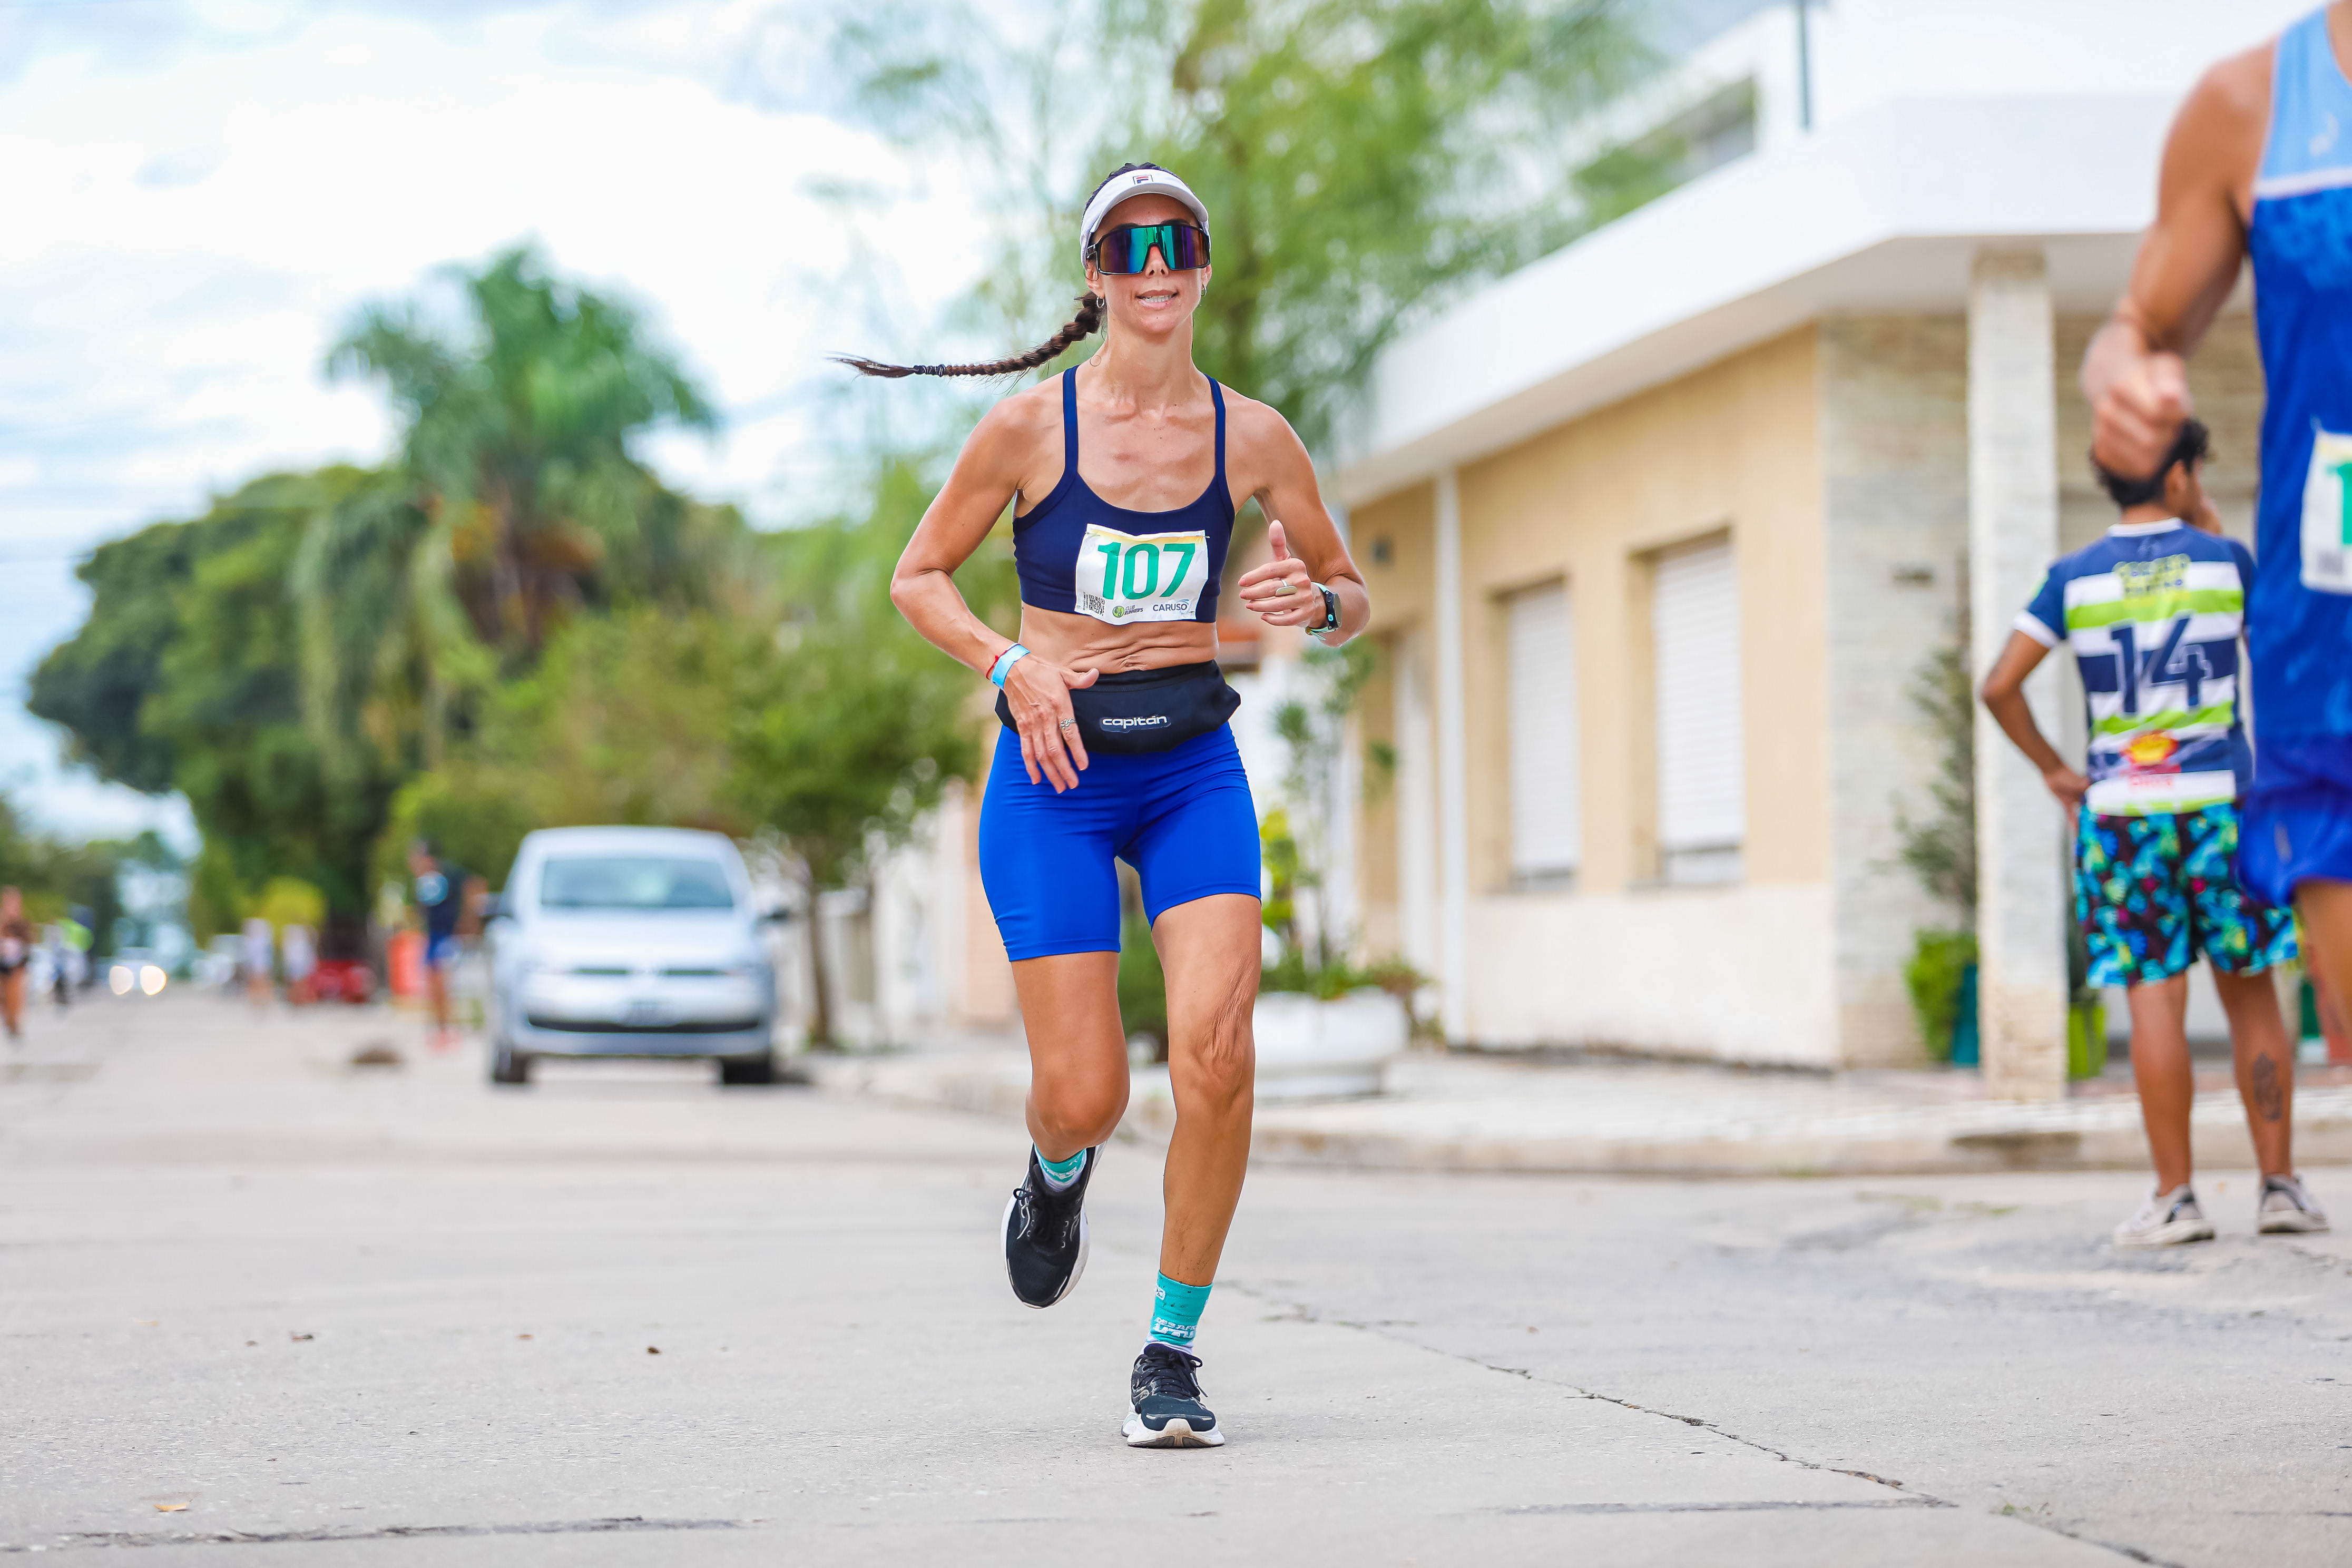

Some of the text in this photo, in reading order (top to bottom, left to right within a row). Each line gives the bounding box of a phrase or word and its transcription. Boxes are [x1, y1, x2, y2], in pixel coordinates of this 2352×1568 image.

[1097, 542, 1195, 600] 107
[1153, 603, 1188, 612] CARUSO
[2109, 613, 2211, 714] 14
[1102, 716, 1168, 729] capitán
